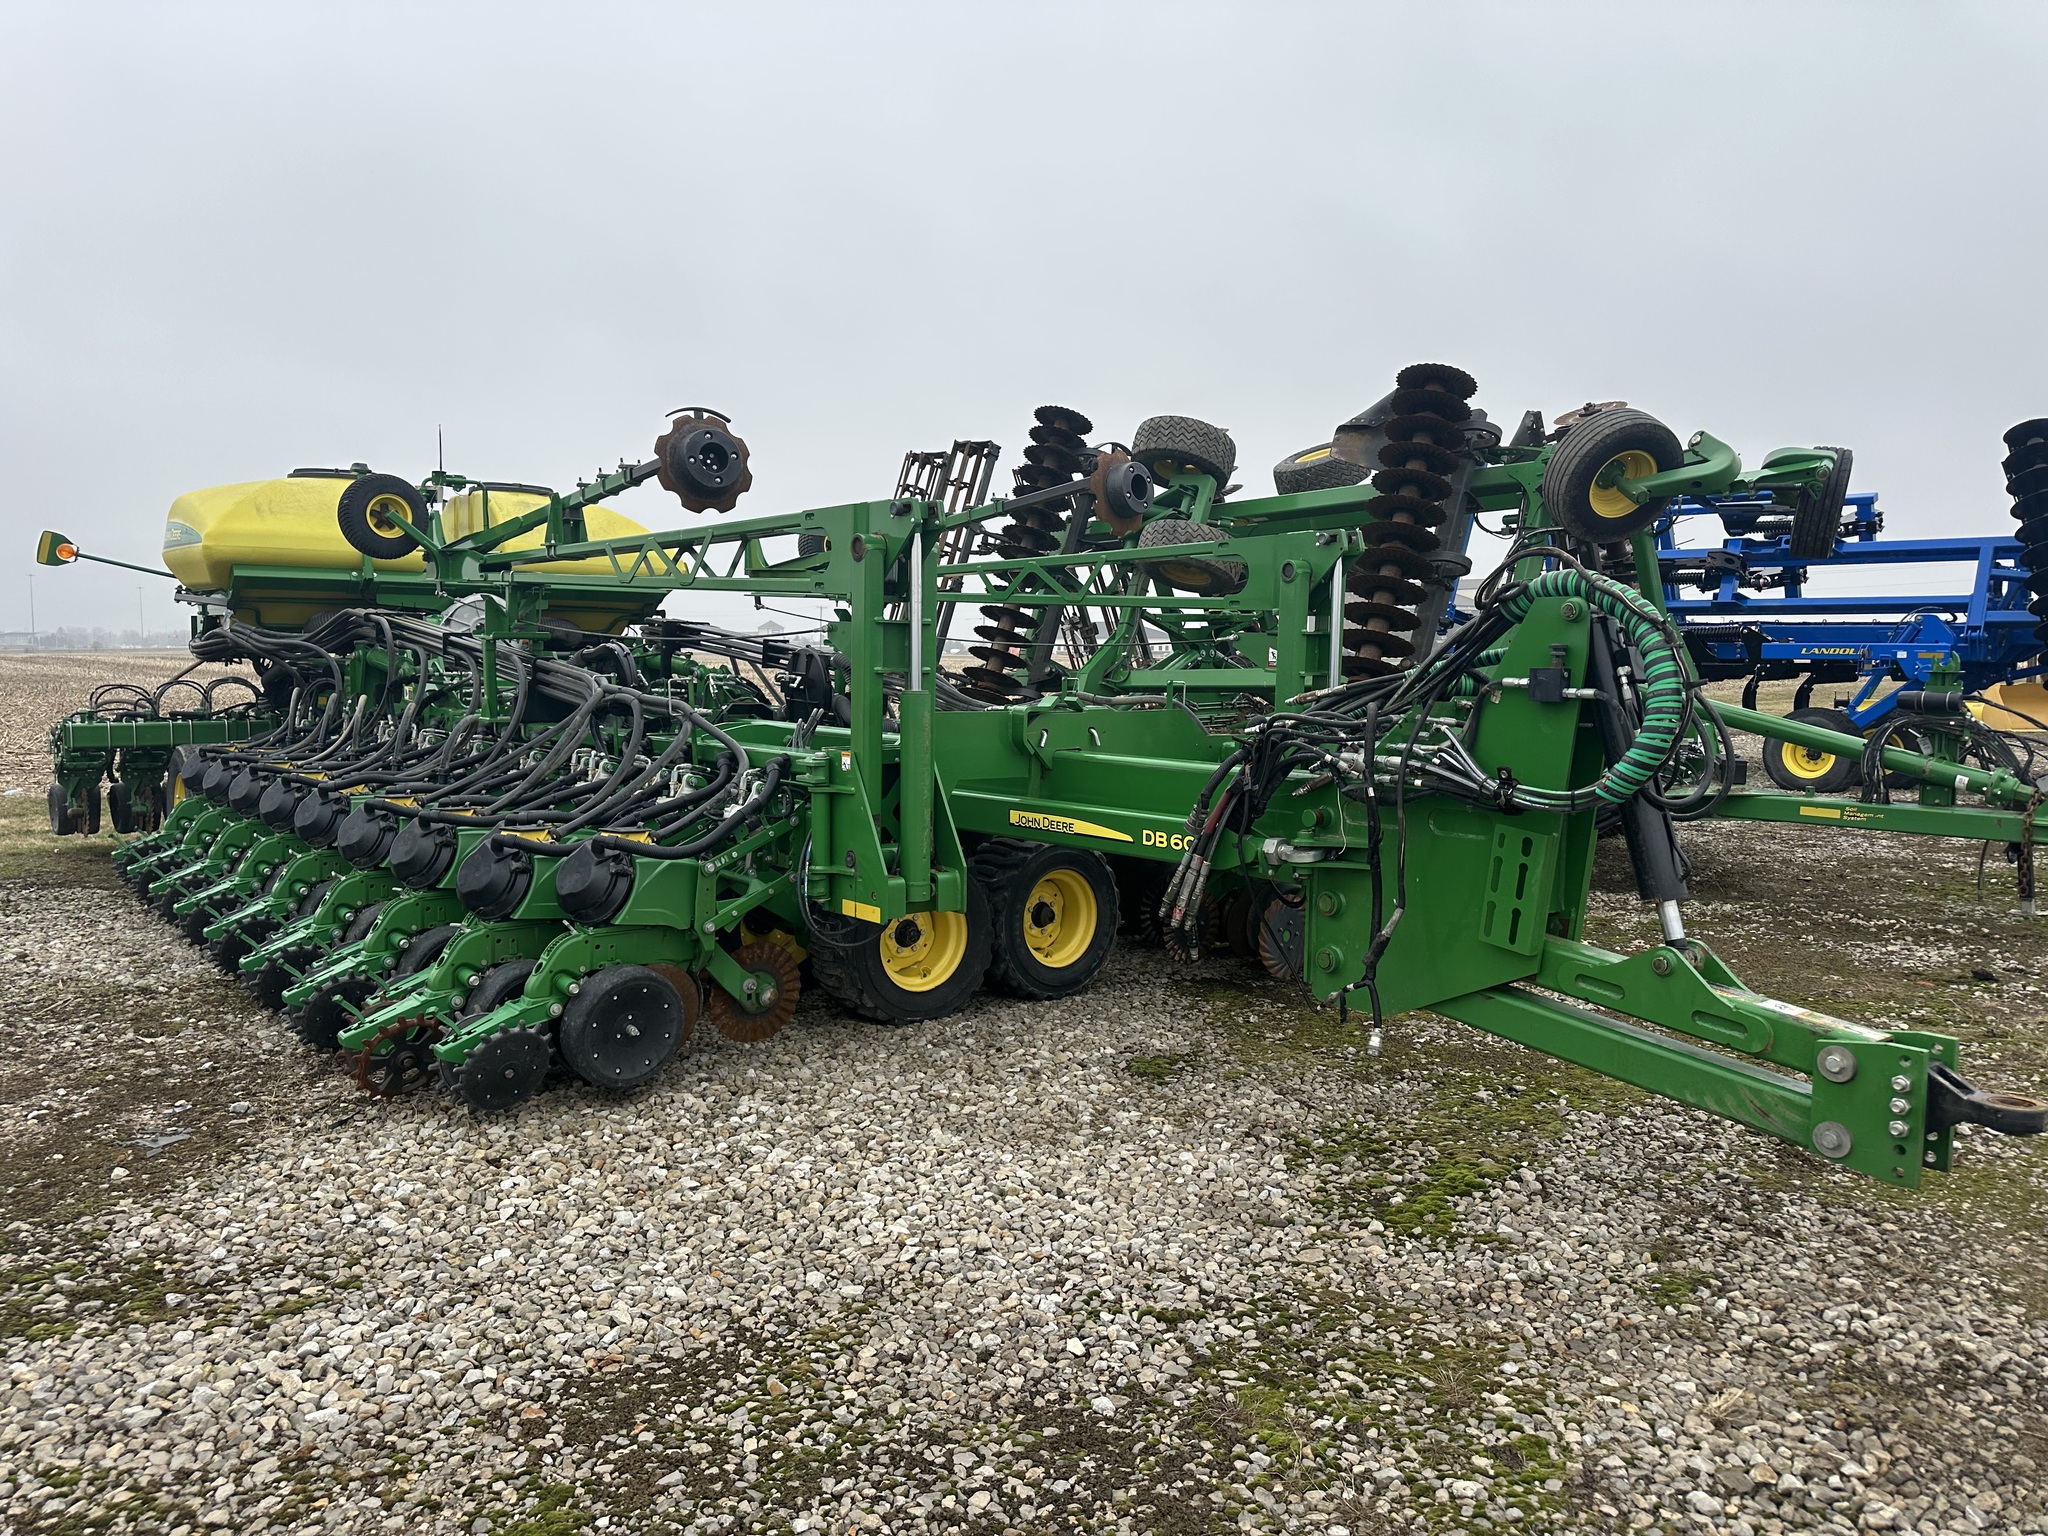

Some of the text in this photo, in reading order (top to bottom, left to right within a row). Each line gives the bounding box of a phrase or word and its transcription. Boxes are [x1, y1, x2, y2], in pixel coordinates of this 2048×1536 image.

[1015, 813, 1075, 833] JOHN DEERE
[1142, 829, 1168, 848] DB
